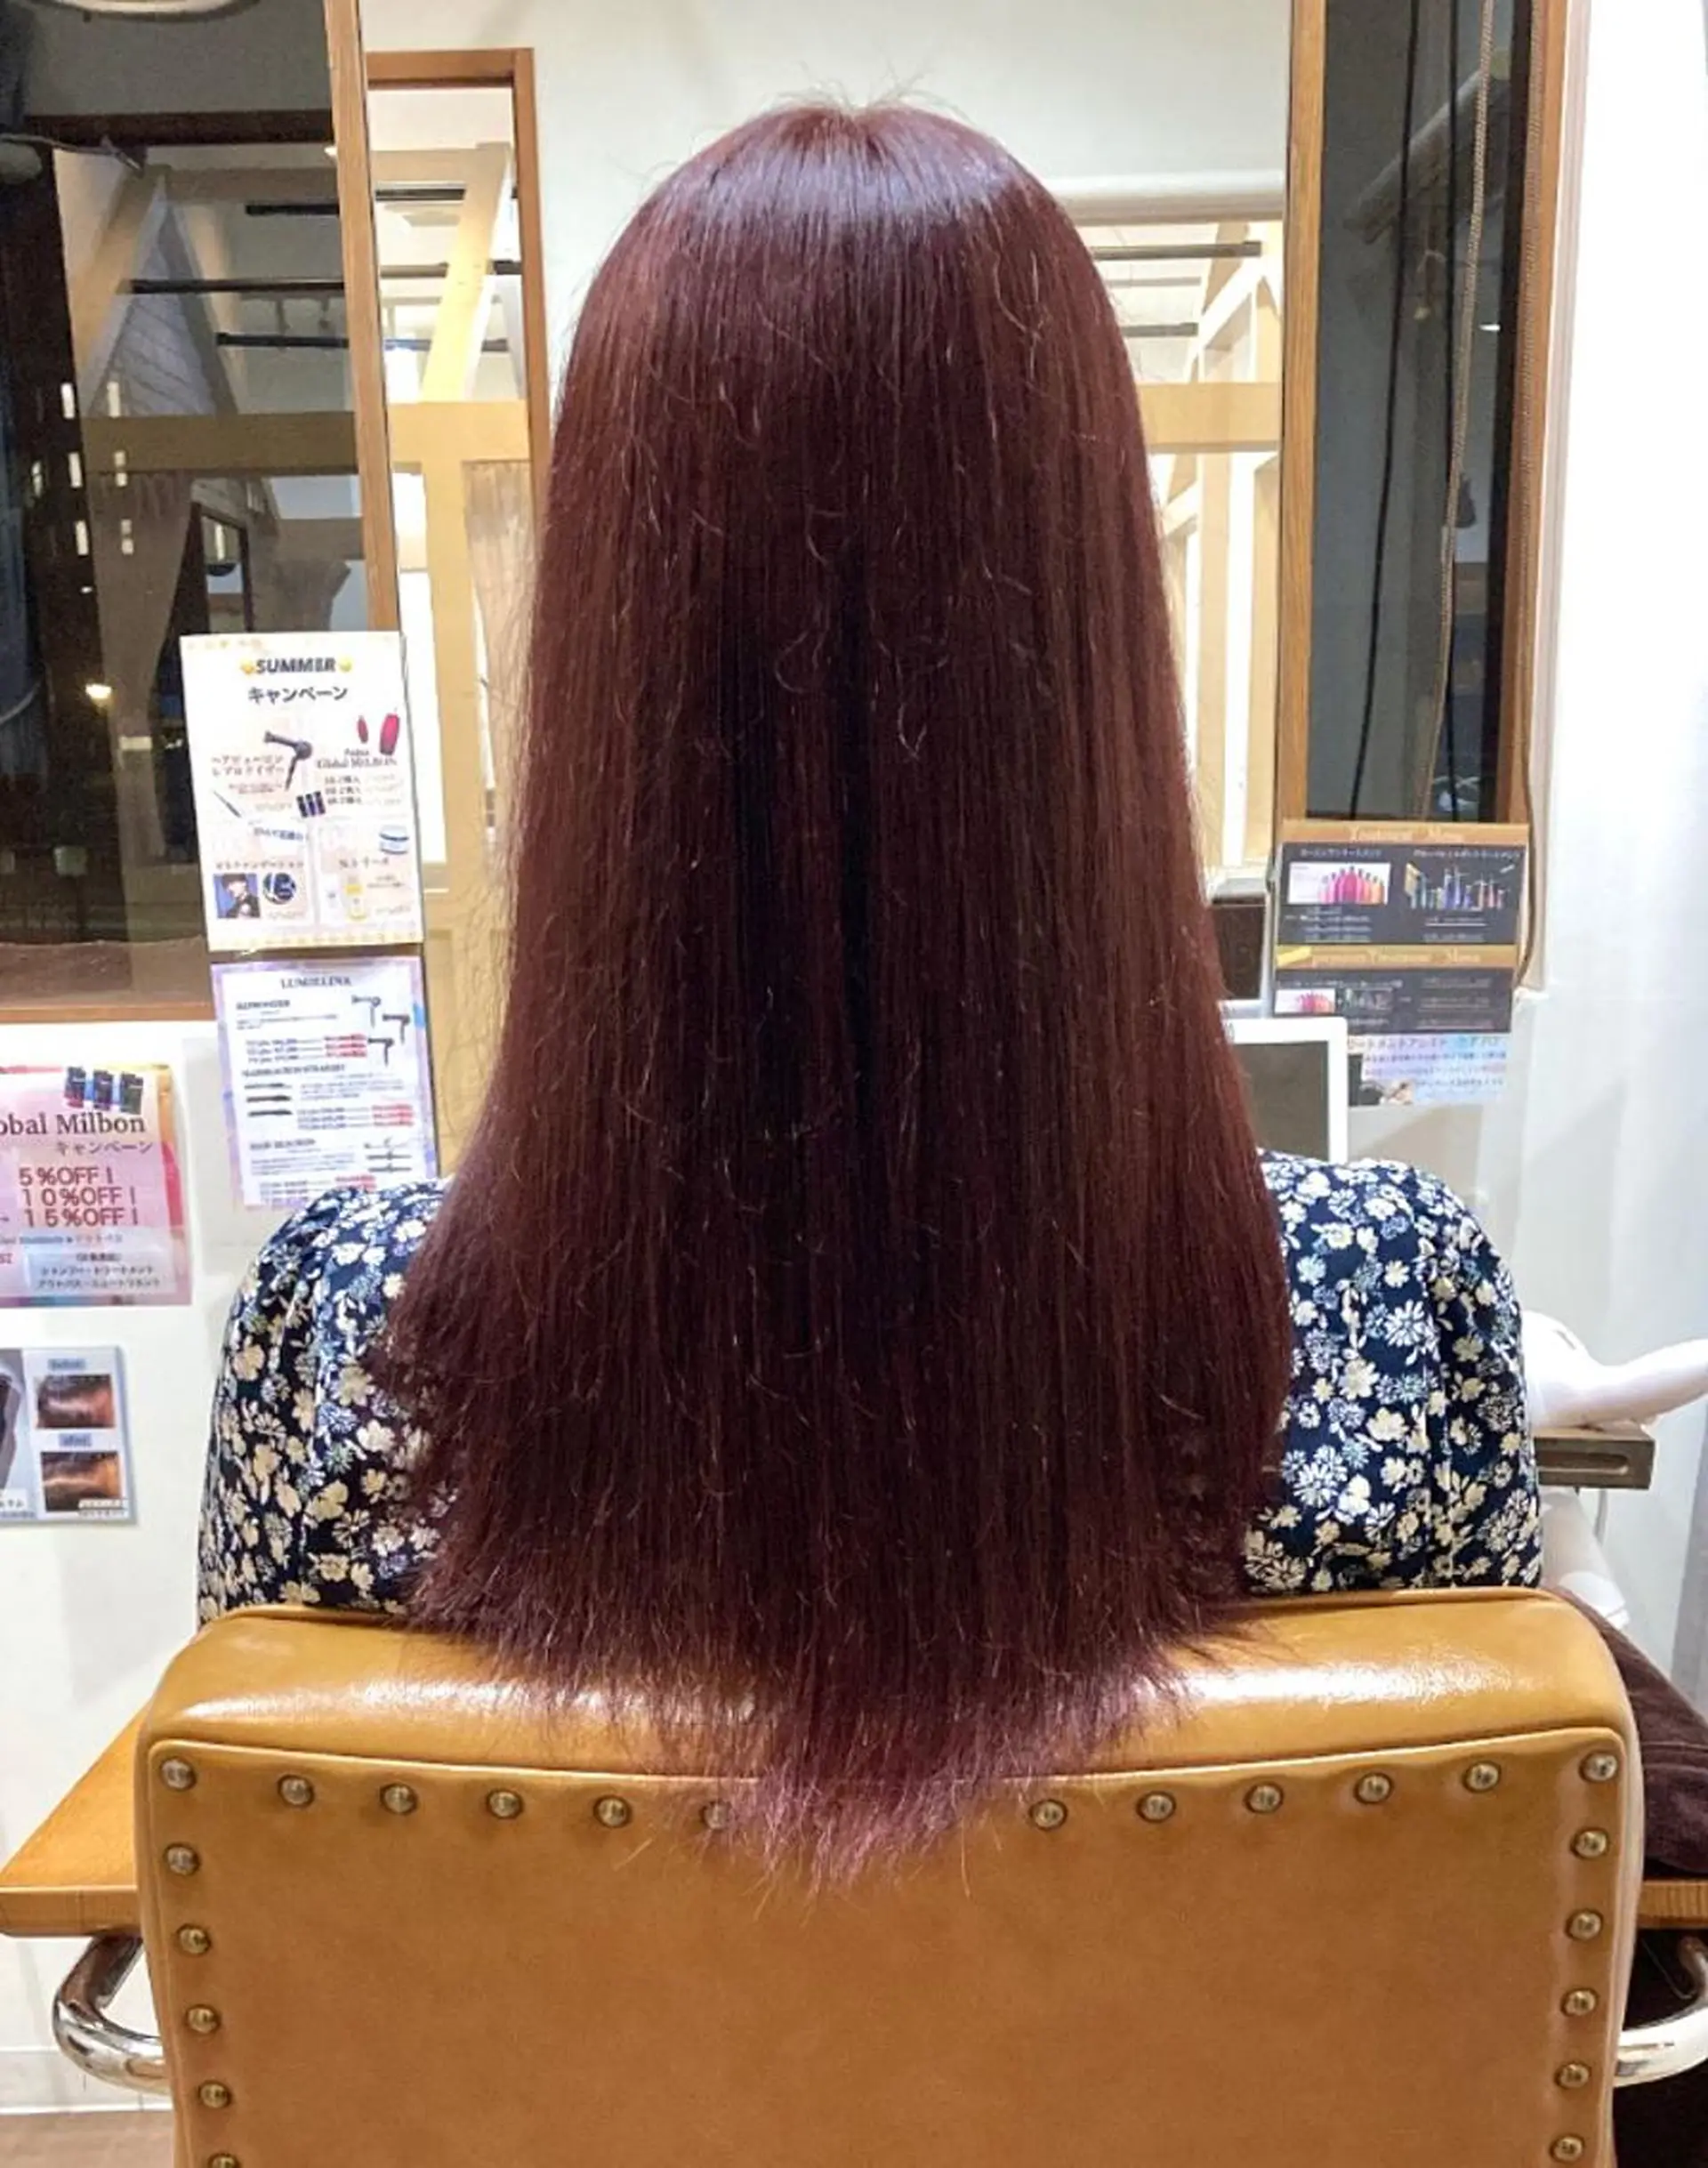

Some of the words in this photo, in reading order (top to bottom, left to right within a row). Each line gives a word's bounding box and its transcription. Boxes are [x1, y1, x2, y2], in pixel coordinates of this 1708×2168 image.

[256, 657, 336, 674] SUMMER
[248, 686, 348, 705] キャンペーン
[56, 1112, 147, 1134] Milbon
[57, 1141, 153, 1157] キャンペーン
